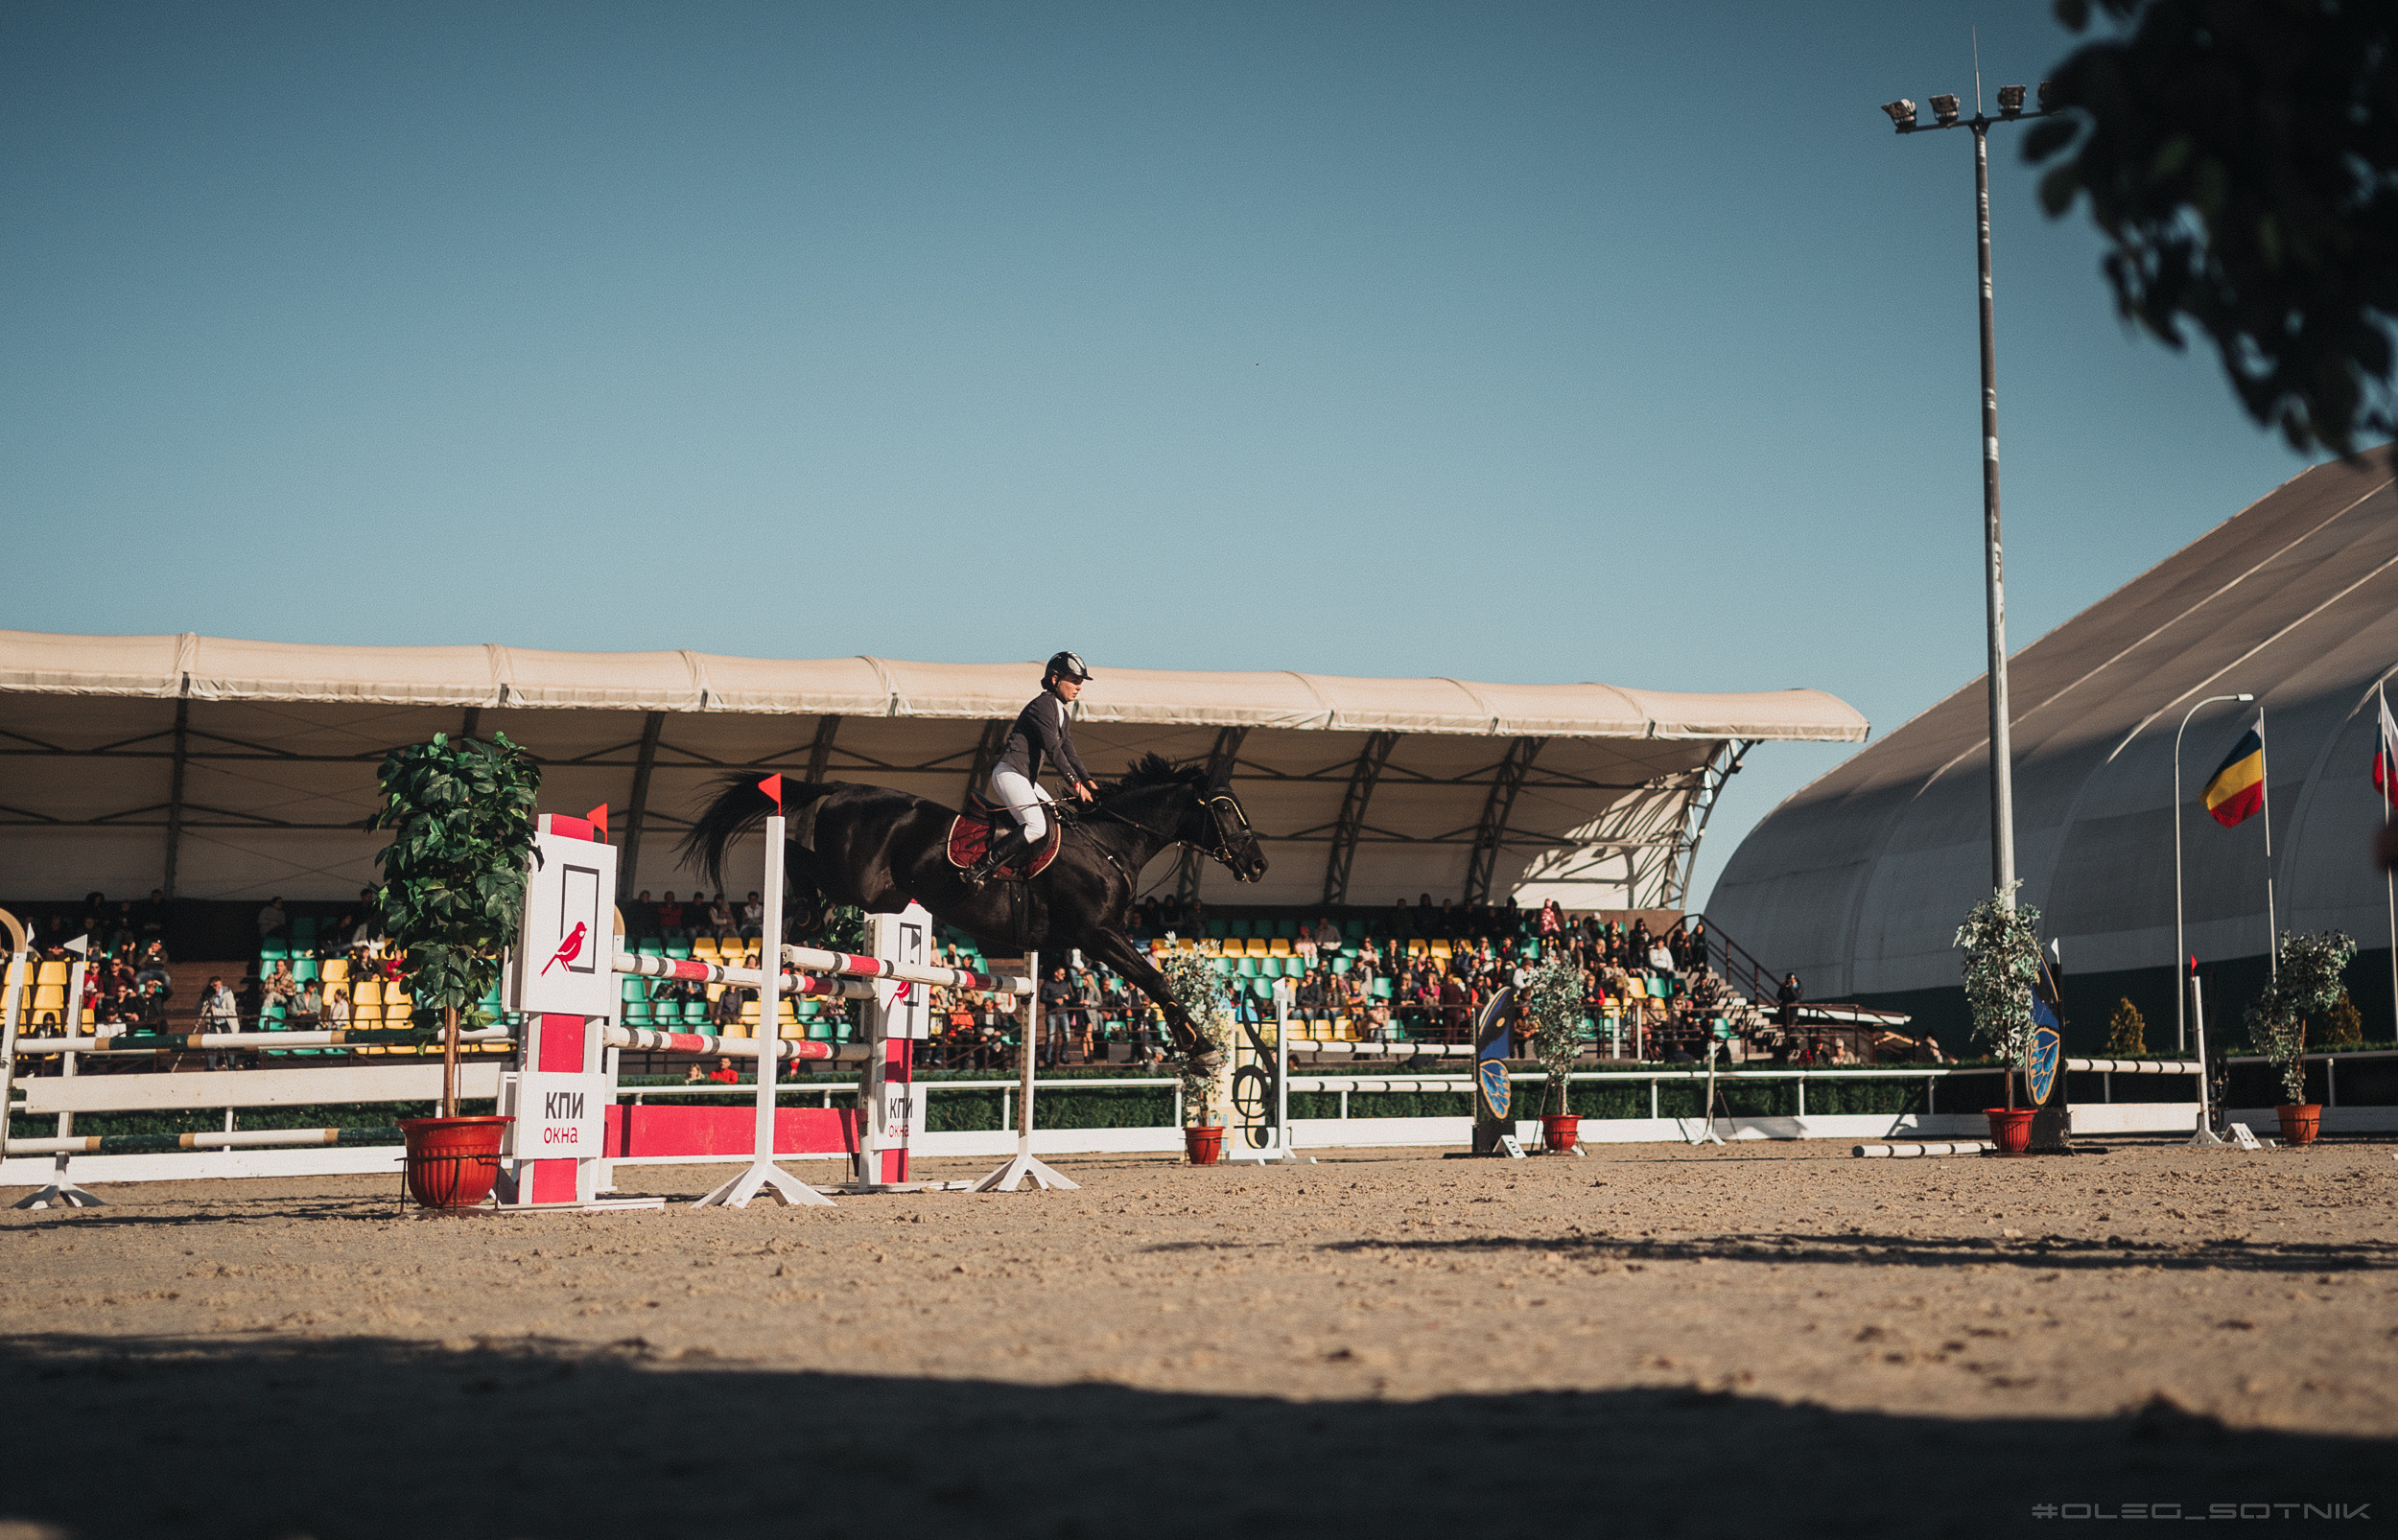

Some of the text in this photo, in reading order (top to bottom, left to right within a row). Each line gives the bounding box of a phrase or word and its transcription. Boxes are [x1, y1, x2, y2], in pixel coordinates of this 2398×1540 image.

[545, 1091, 584, 1119] КПИ
[889, 1097, 913, 1119] КПИ
[543, 1127, 578, 1144] окна
[888, 1124, 909, 1138] окна
